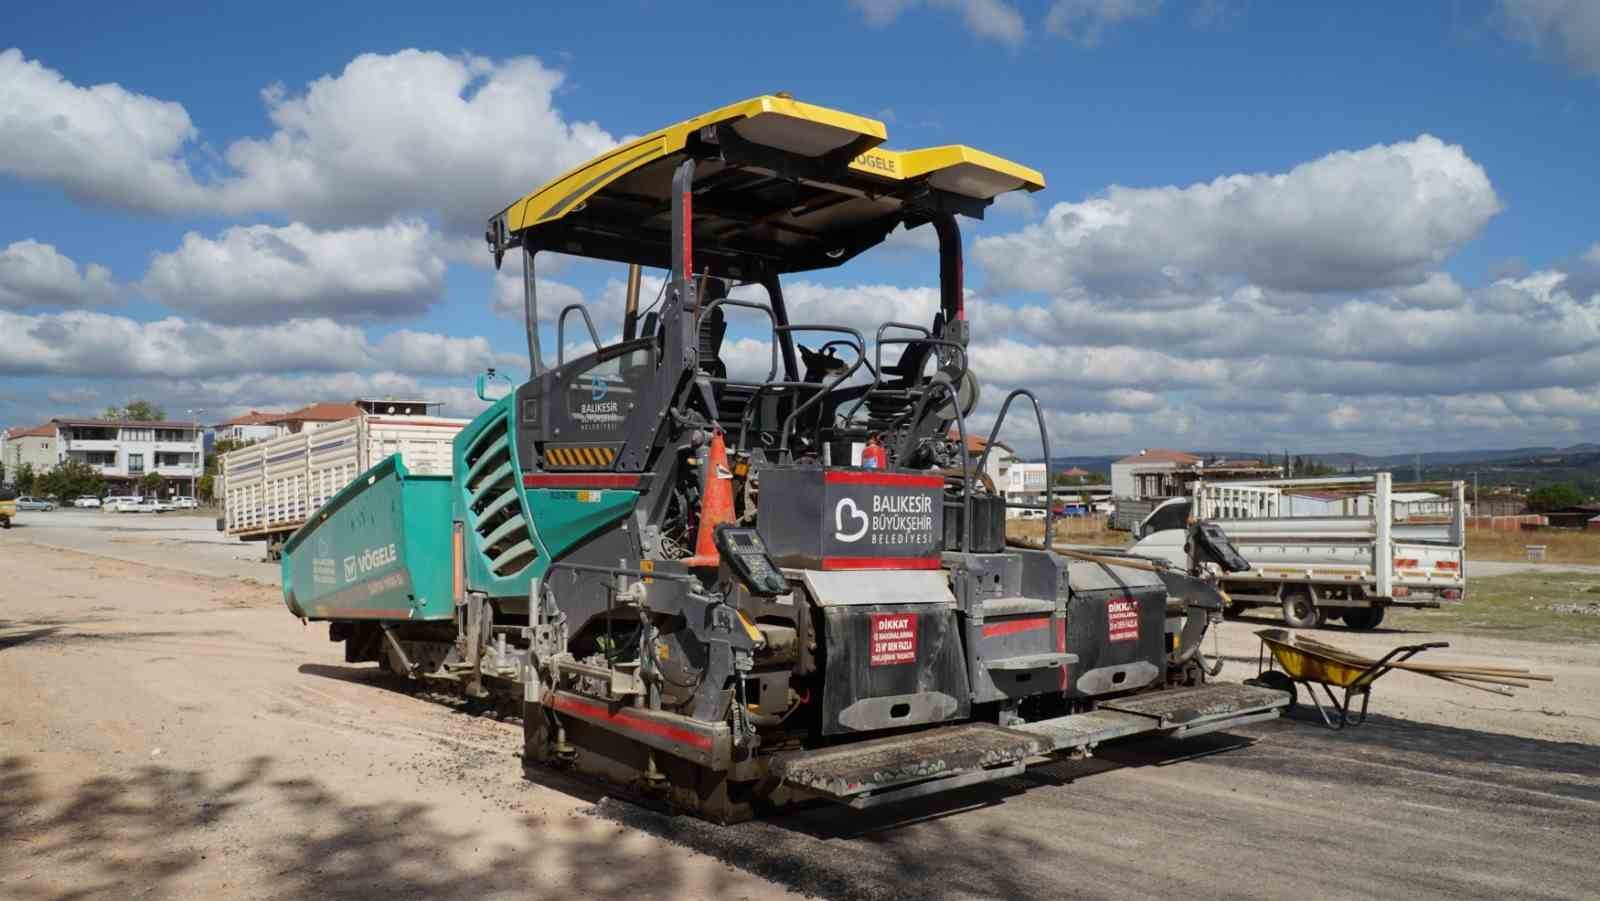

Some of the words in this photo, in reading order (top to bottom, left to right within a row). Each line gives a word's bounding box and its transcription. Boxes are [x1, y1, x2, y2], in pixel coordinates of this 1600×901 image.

[581, 400, 618, 413] BALIKESİR
[873, 493, 932, 513] BALIKESİR
[872, 514, 932, 534] BÜYÜKŞEHİR
[871, 532, 933, 544] BELEDİYESİ
[357, 545, 397, 573] VÖGELE
[878, 618, 909, 630] DİKKAT
